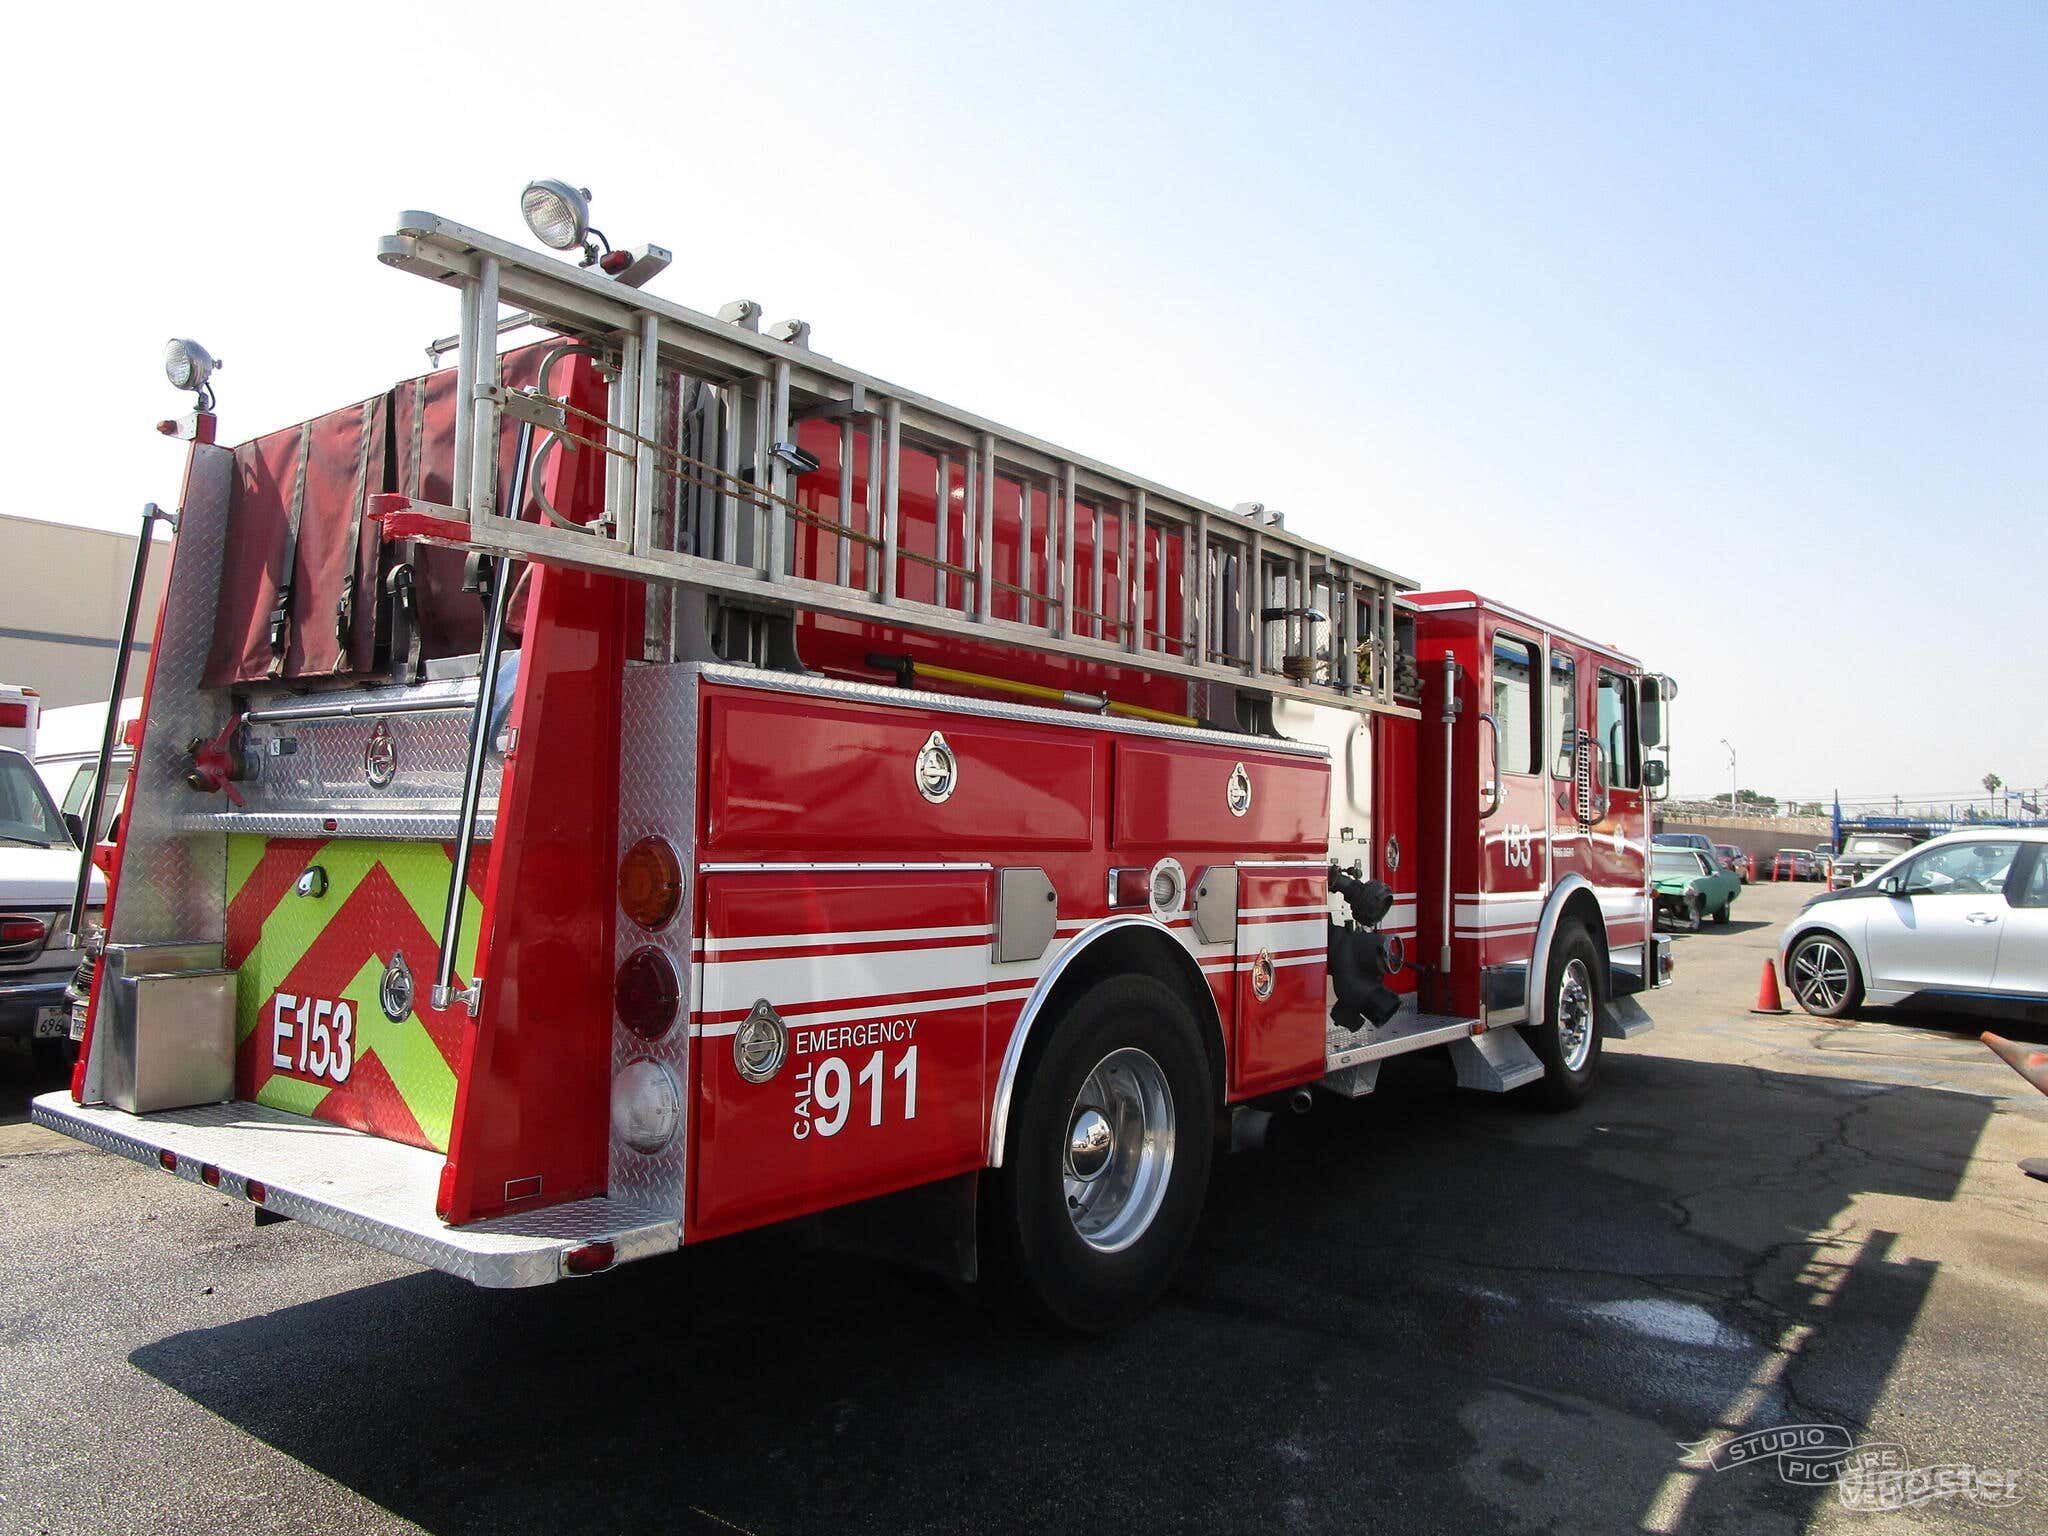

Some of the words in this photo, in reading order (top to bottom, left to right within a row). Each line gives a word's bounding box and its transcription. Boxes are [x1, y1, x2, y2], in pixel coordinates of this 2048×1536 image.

[1501, 823, 1532, 868] 153
[273, 992, 353, 1084] E153
[796, 1018, 917, 1055] EMERGENCY
[792, 1061, 813, 1141] CALL
[814, 1044, 918, 1137] 911
